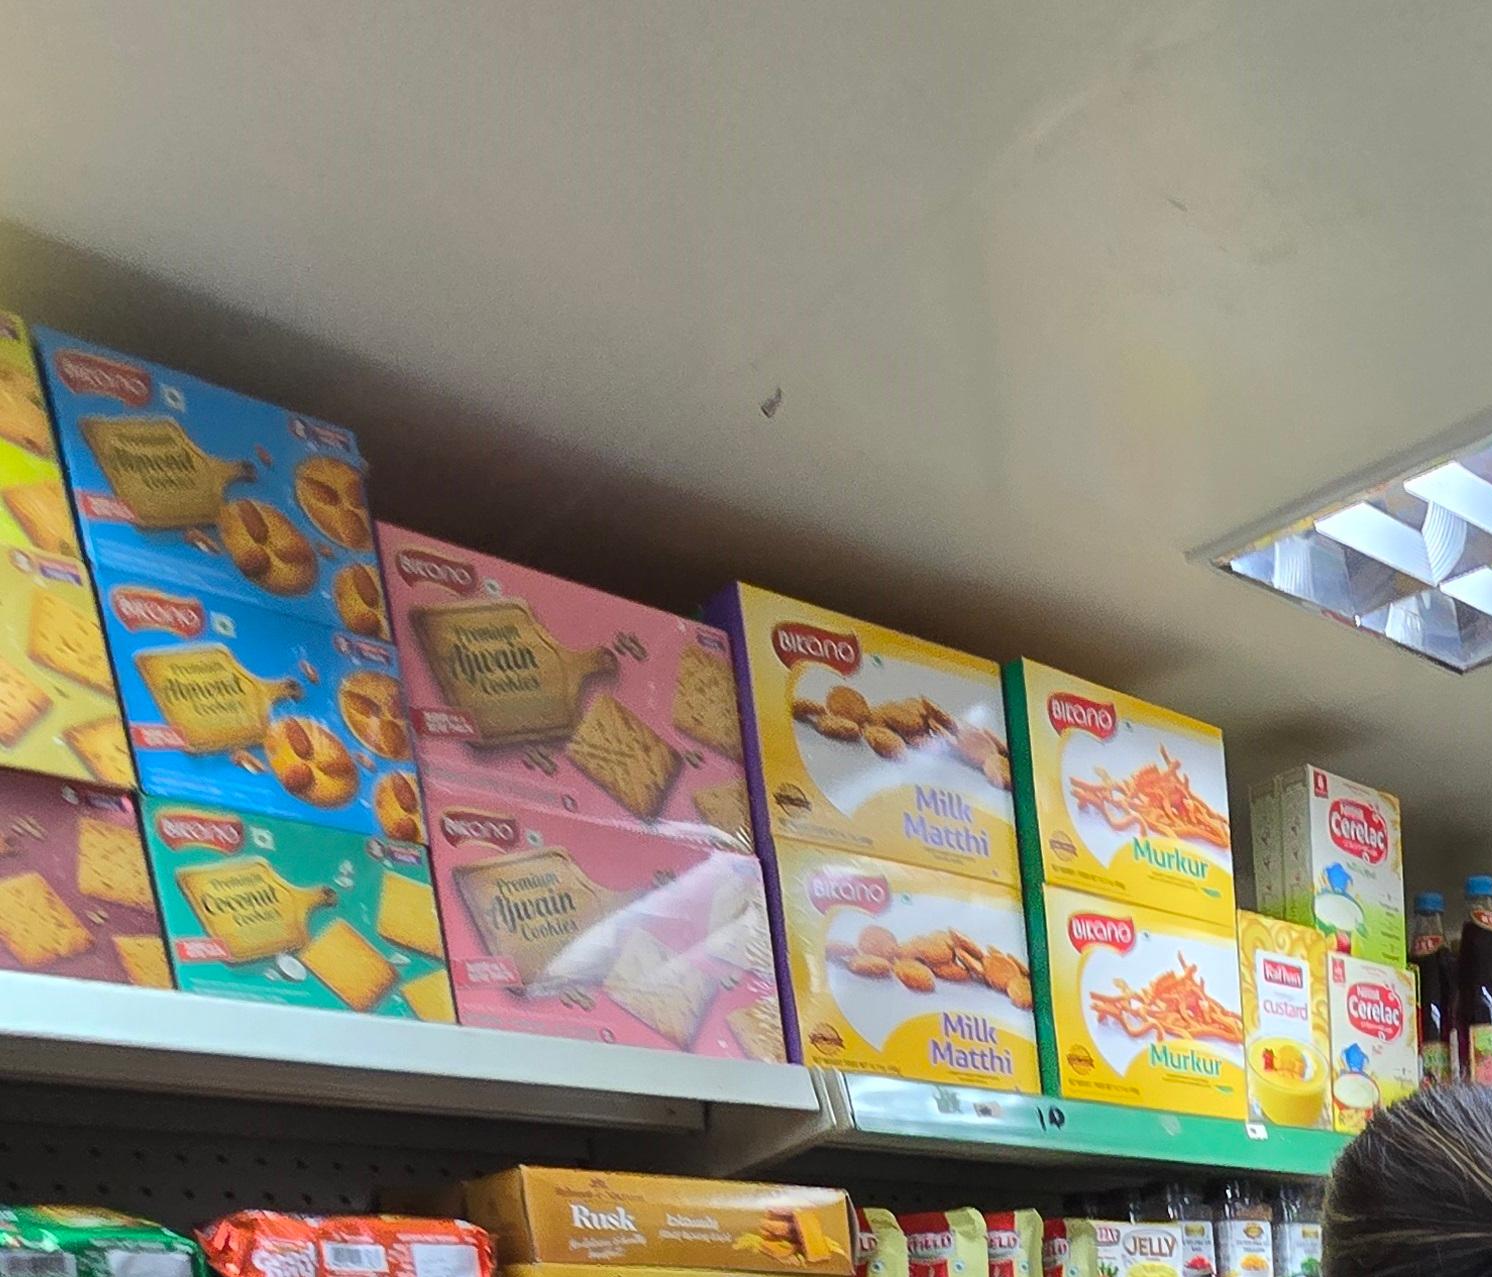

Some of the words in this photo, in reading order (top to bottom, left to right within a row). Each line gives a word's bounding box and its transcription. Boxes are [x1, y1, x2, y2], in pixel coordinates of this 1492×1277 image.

[915, 783, 974, 825] Milk
[902, 813, 990, 858] Matthi
[1330, 814, 1387, 851] Cerelac
[1131, 837, 1209, 881] Murkur
[1262, 997, 1309, 1022] custard
[1349, 997, 1401, 1028] Cerelac
[942, 1011, 998, 1045] Milk
[930, 1039, 1013, 1075] Matthi
[1149, 1042, 1223, 1077] Murkur
[567, 1202, 638, 1233] Rusk
[1127, 1235, 1177, 1257] JELLY
